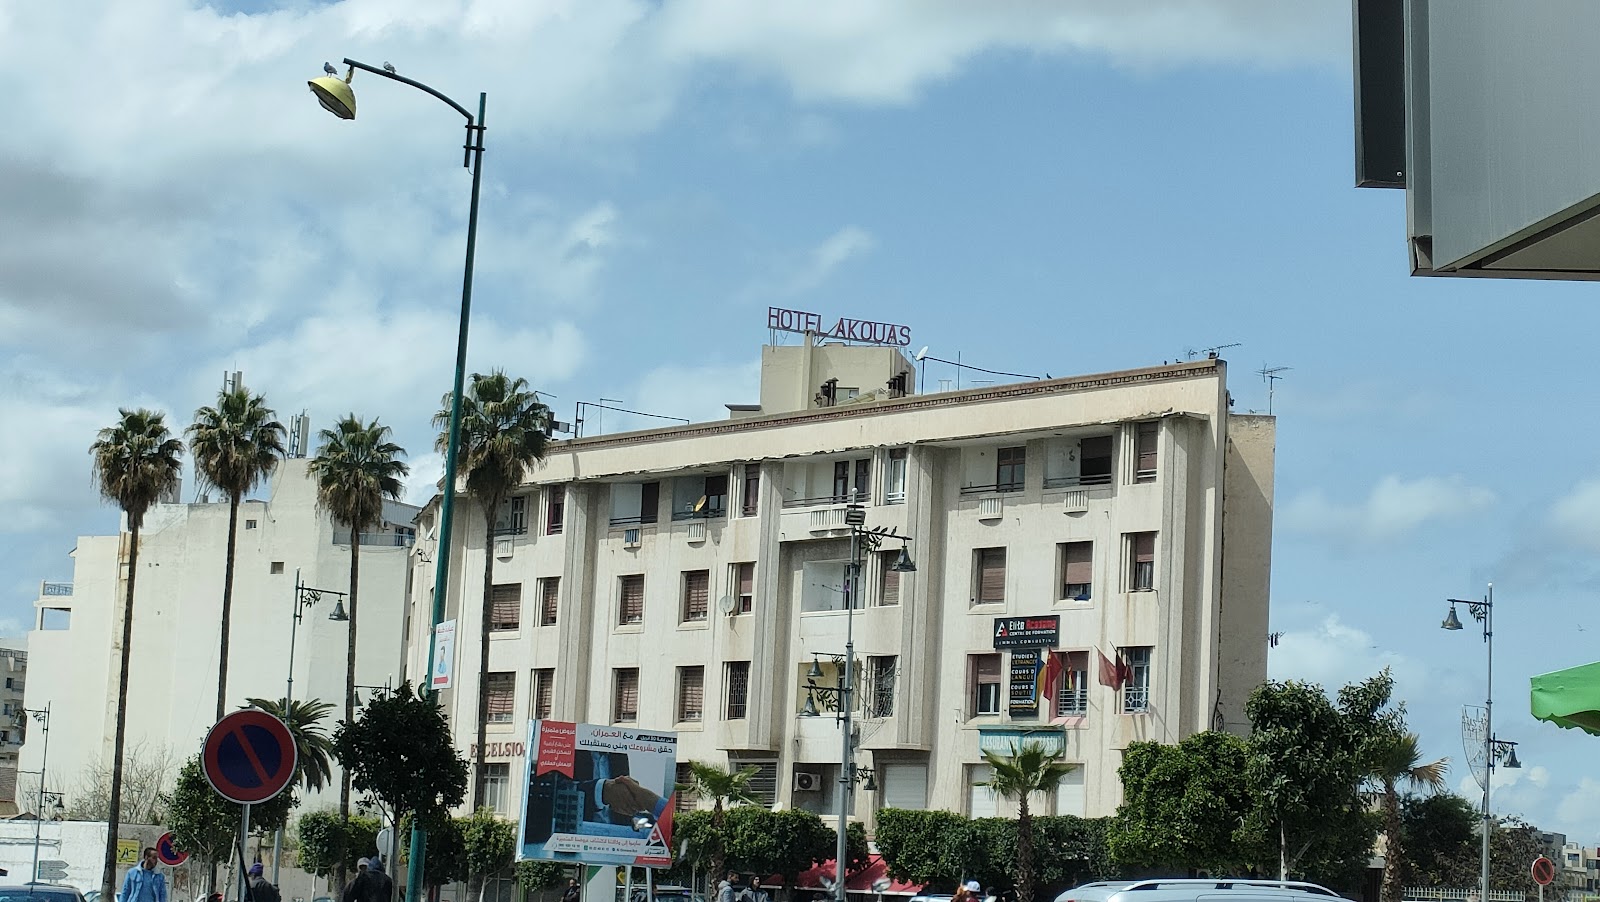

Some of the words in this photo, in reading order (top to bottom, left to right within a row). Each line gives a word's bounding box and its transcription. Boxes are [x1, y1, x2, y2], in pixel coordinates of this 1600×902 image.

[767, 306, 822, 336] HOTEL
[835, 318, 911, 346] AKOUAS
[1010, 620, 1025, 630] Elite
[579, 739, 612, 748] مستقبلك
[629, 743, 657, 752] مشروعك
[470, 742, 526, 758] ECELSIO
[657, 745, 673, 753] حقق
